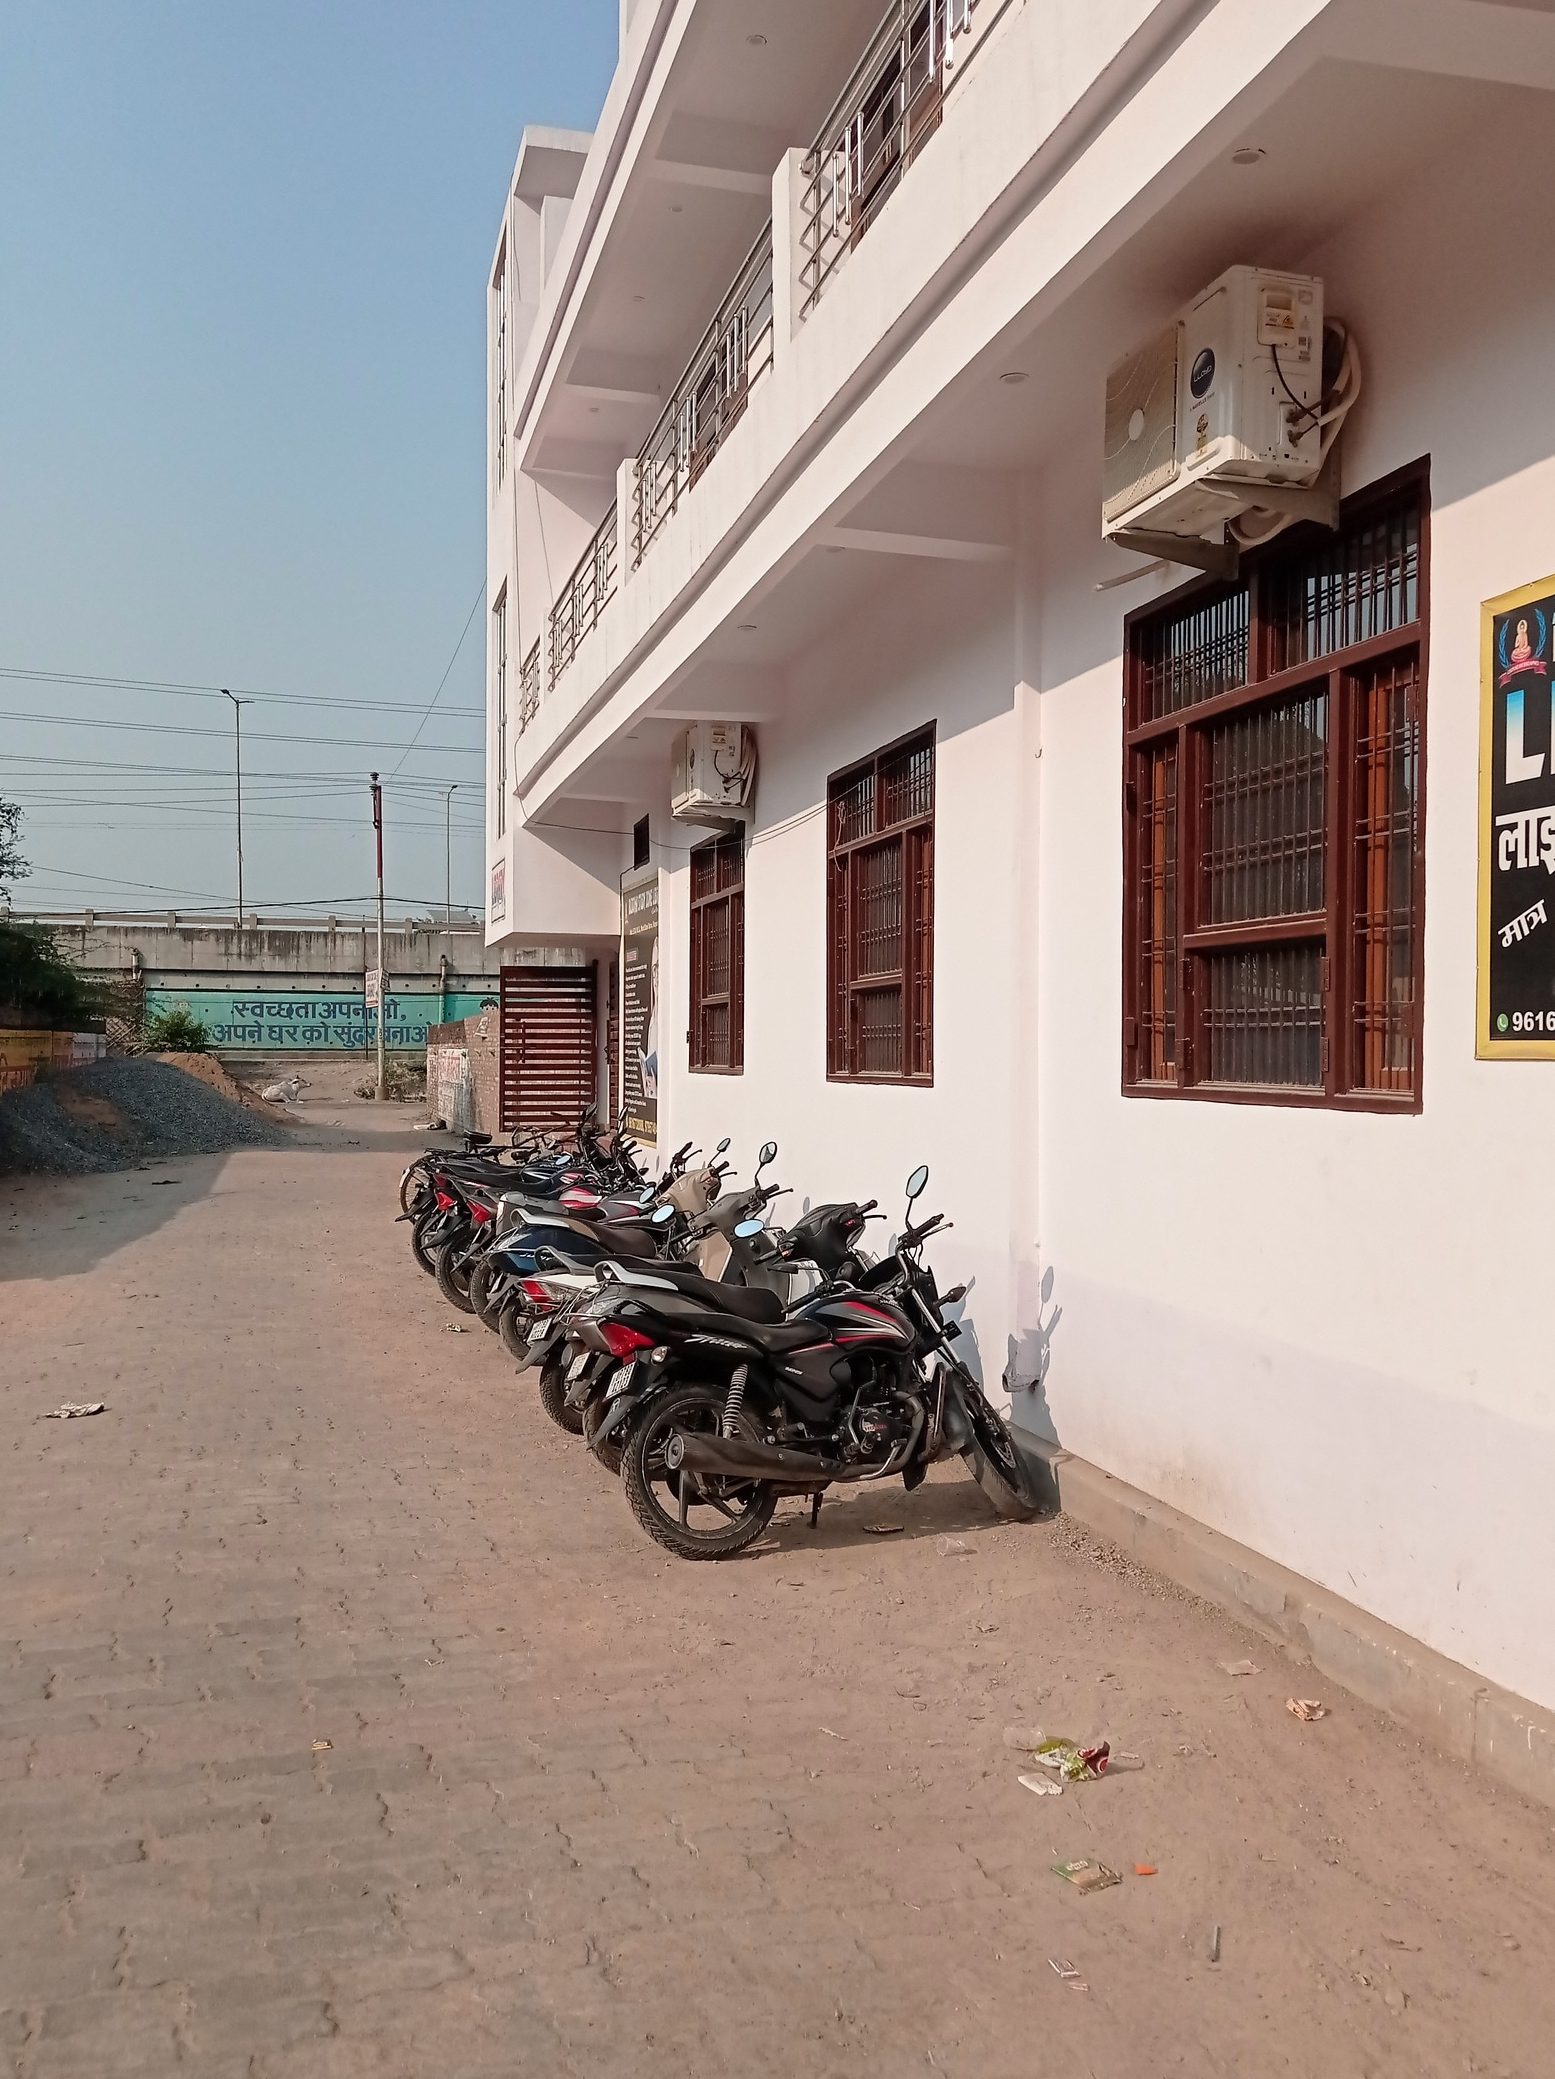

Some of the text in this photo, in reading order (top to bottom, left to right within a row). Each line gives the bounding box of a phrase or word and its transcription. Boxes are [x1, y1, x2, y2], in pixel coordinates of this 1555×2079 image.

[1498, 899, 1548, 948] मात्र
[233, 1001, 317, 1020] स्वच्छता
[1512, 1010, 1555, 1032] 9616
[213, 1020, 265, 1042] अपने
[267, 1025, 300, 1042] घर
[301, 1021, 331, 1043] को
